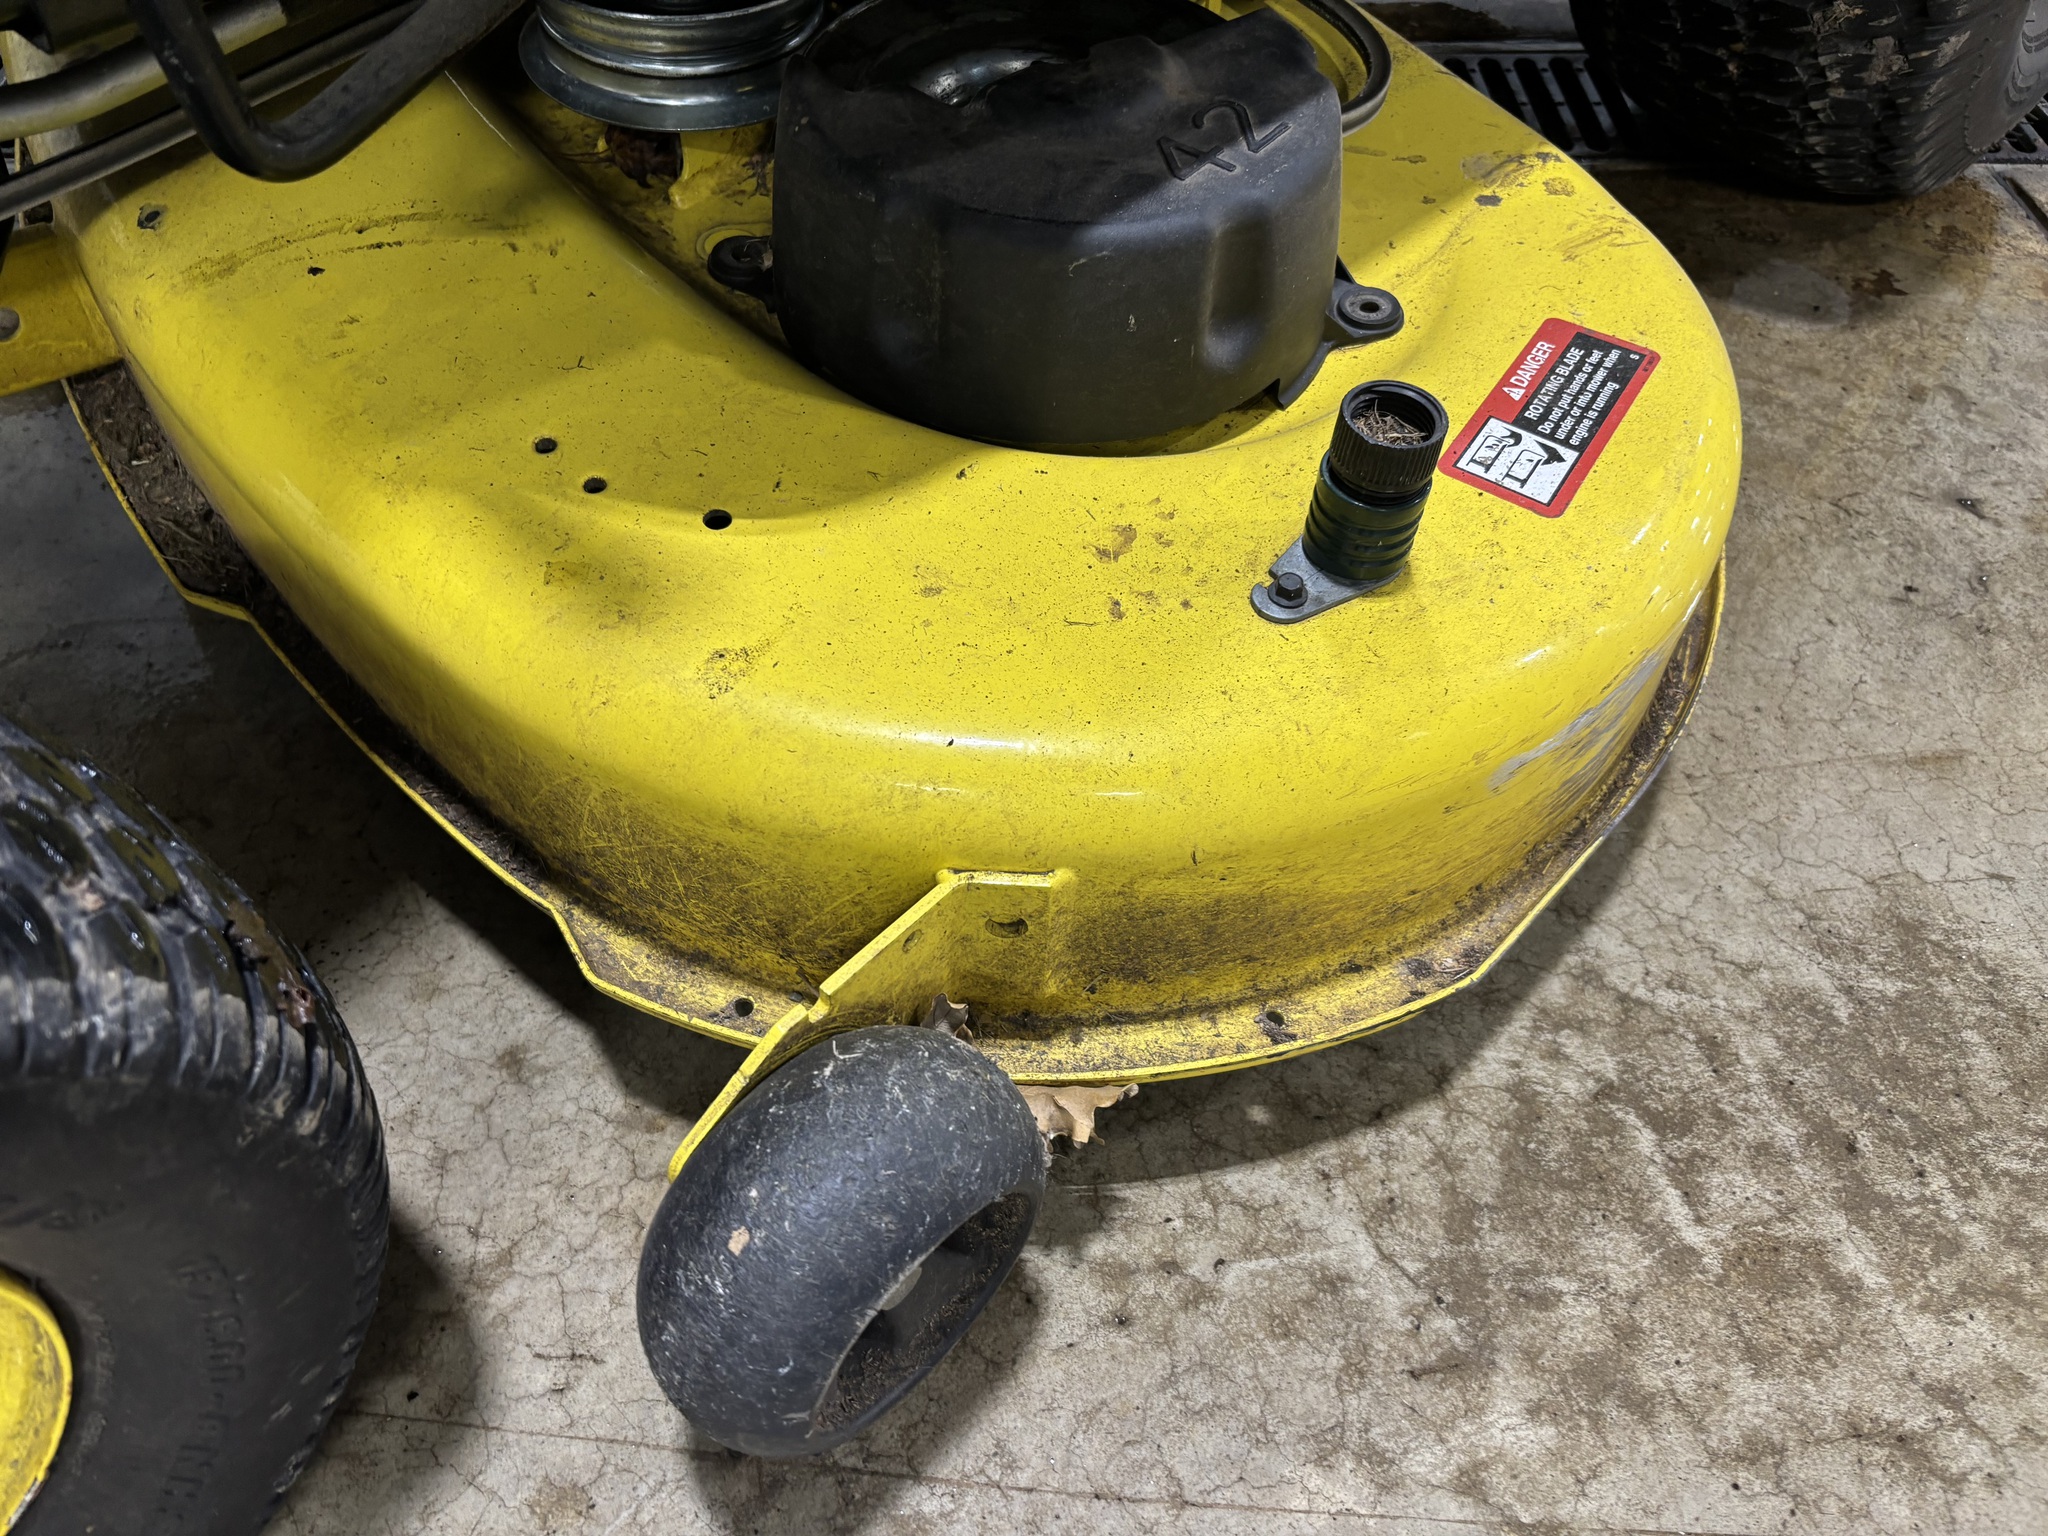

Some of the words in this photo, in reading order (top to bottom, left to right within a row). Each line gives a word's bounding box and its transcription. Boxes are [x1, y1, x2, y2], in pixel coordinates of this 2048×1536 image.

[1157, 100, 1292, 181] 42
[1509, 341, 1557, 388] DANGER
[1585, 349, 1604, 365] feet
[1602, 349, 1622, 369] when
[1582, 362, 1594, 373] or
[1524, 374, 1565, 421] ROTATING
[1555, 346, 1585, 376] BLADE
[1564, 372, 1588, 396] hands
[1587, 367, 1609, 393] mower
[1557, 394, 1574, 410] put
[1573, 393, 1593, 408] into
[1548, 407, 1565, 423] not
[1568, 419, 1593, 446] engine
[1583, 410, 1599, 419] is
[1592, 381, 1621, 411] running
[1570, 406, 1583, 417] or
[1537, 421, 1555, 435] Do
[1554, 415, 1576, 440] under
